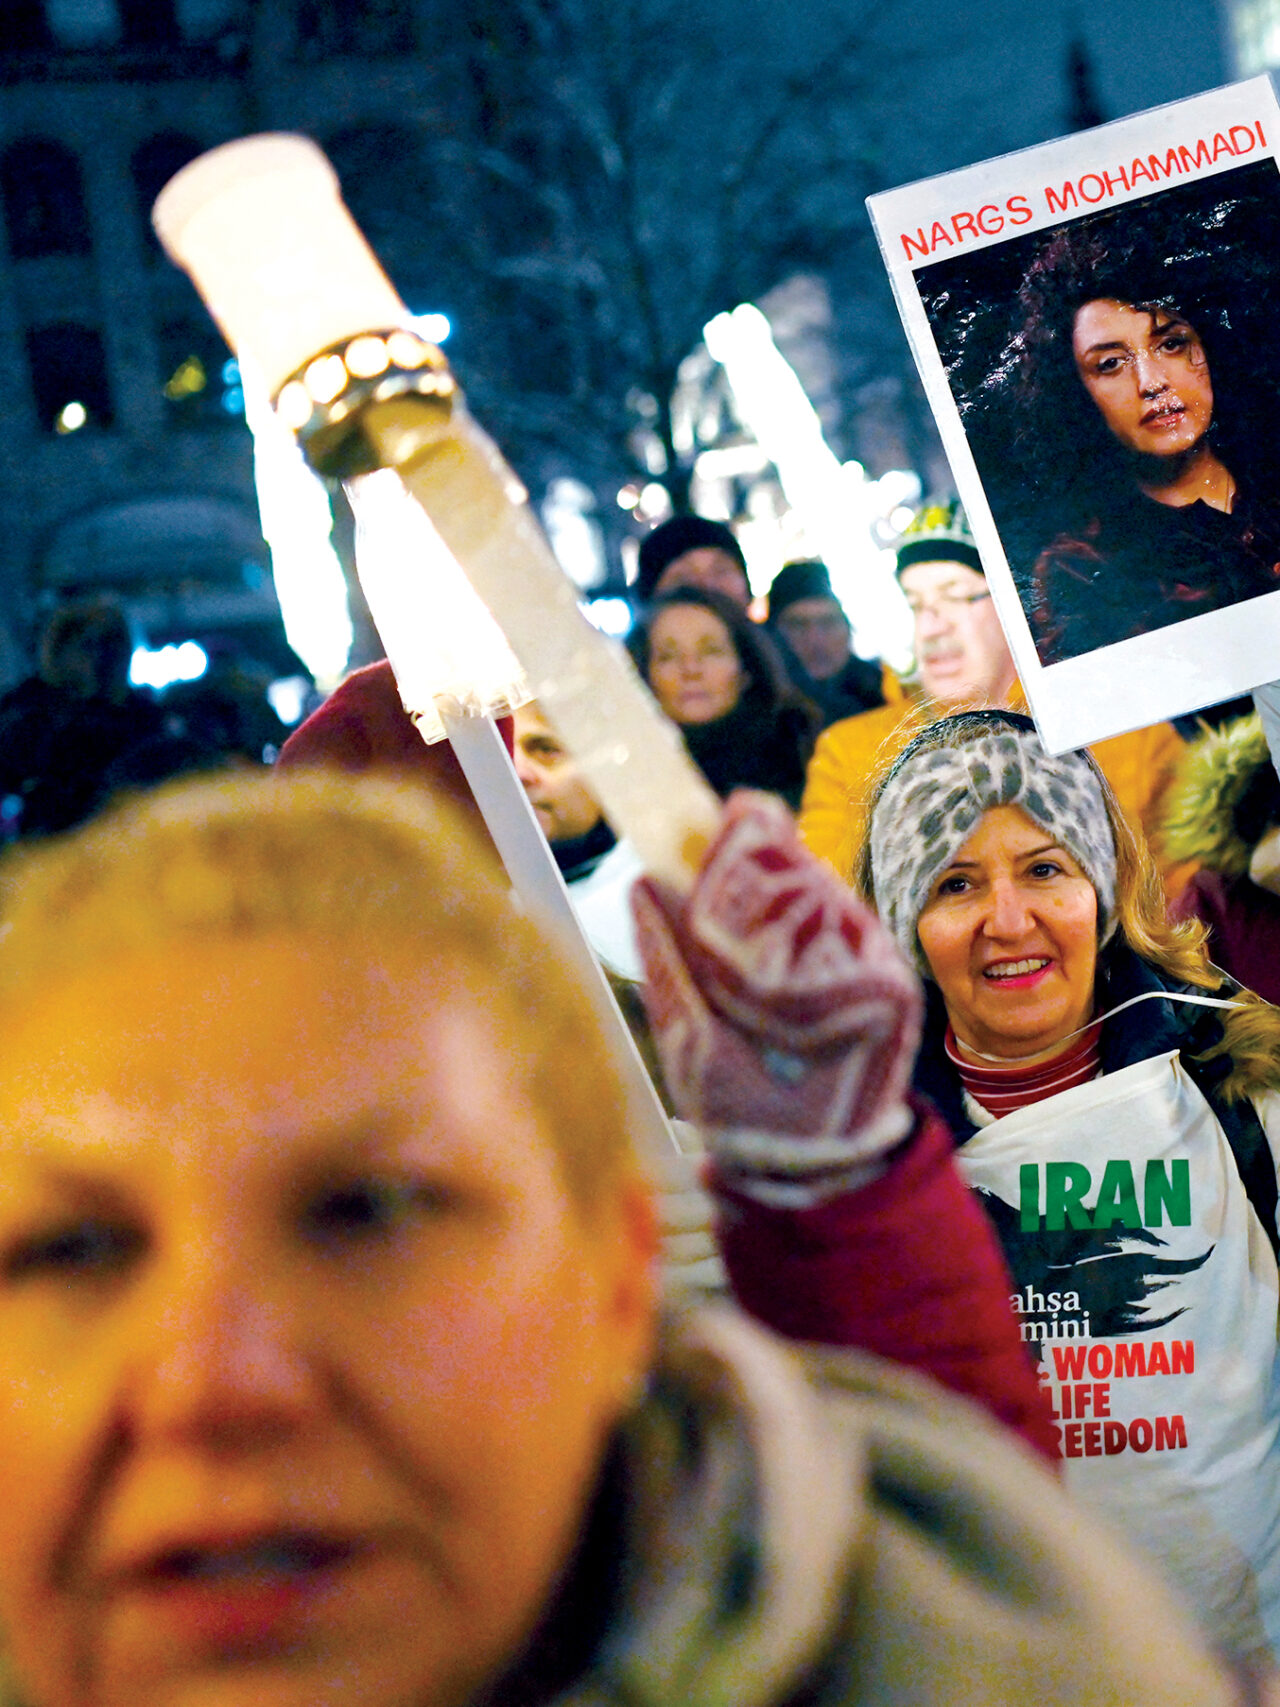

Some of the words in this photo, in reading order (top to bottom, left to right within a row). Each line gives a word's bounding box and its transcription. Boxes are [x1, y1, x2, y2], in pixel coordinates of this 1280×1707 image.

[900, 195, 1033, 261] NARGS
[1045, 120, 1267, 214] MOHAMMADI
[1019, 1159, 1191, 1232] IRAN
[1008, 1284, 1081, 1314] ahsa
[1019, 1310, 1092, 1342] mini
[1052, 1340, 1195, 1381] WOMAN
[1042, 1383, 1111, 1420] LIFE
[1050, 1415, 1188, 1459] REEDOM
